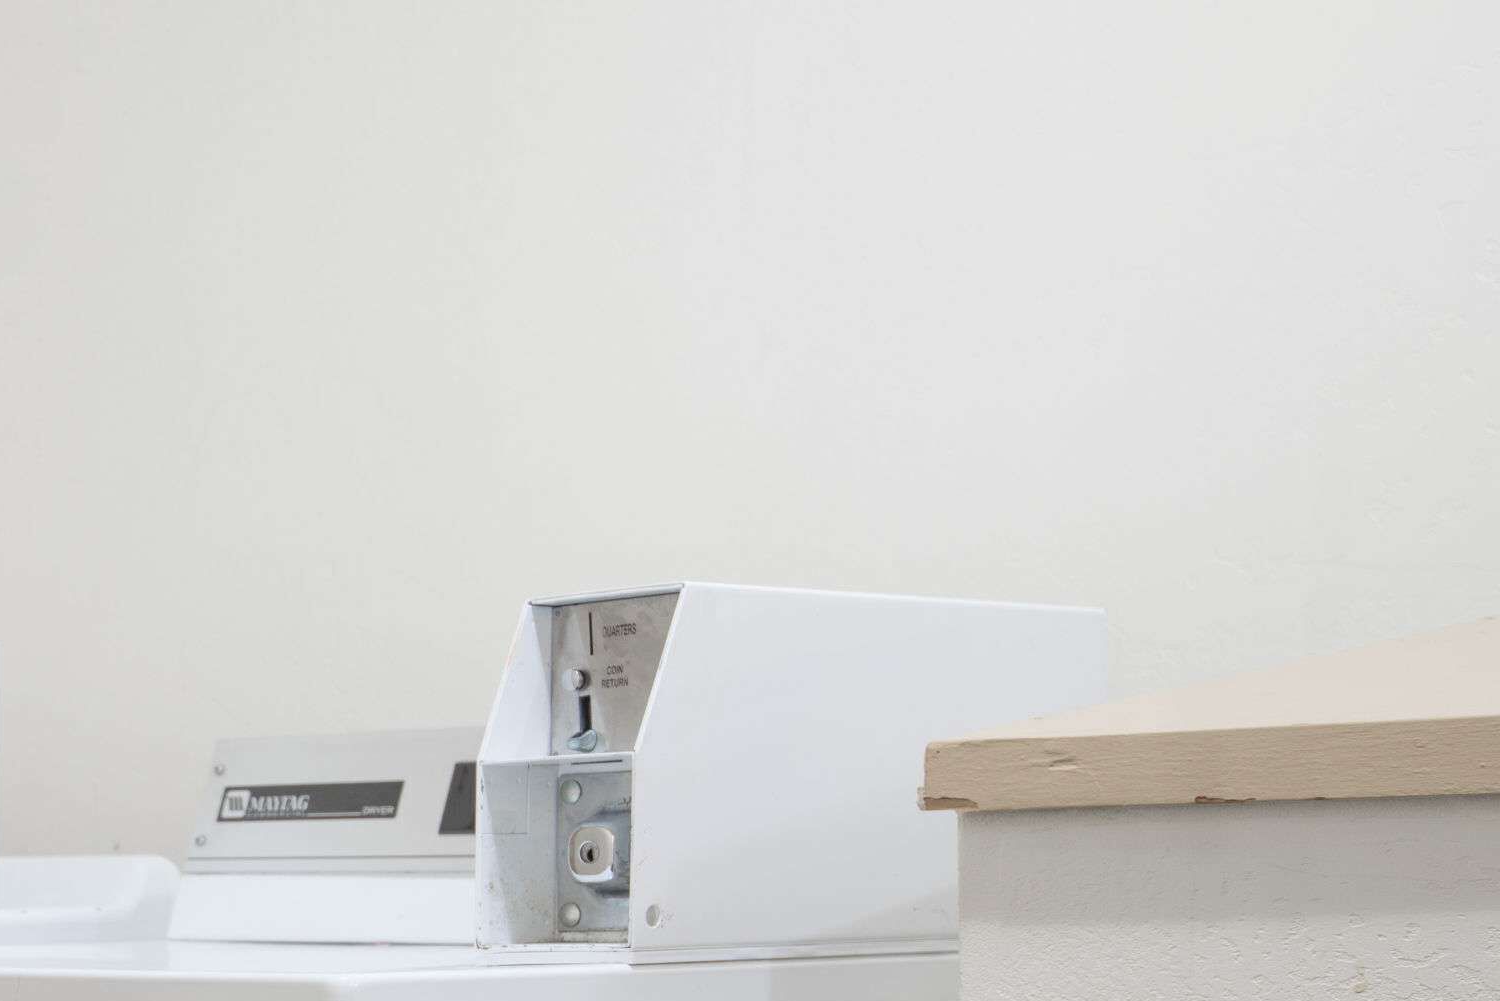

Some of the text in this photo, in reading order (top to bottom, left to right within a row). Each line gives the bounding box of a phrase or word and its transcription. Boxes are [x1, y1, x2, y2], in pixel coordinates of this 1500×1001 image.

[603, 623, 637, 637] QUARTERS
[602, 678, 629, 688] RETURN
[246, 795, 310, 812] MAYTAG
